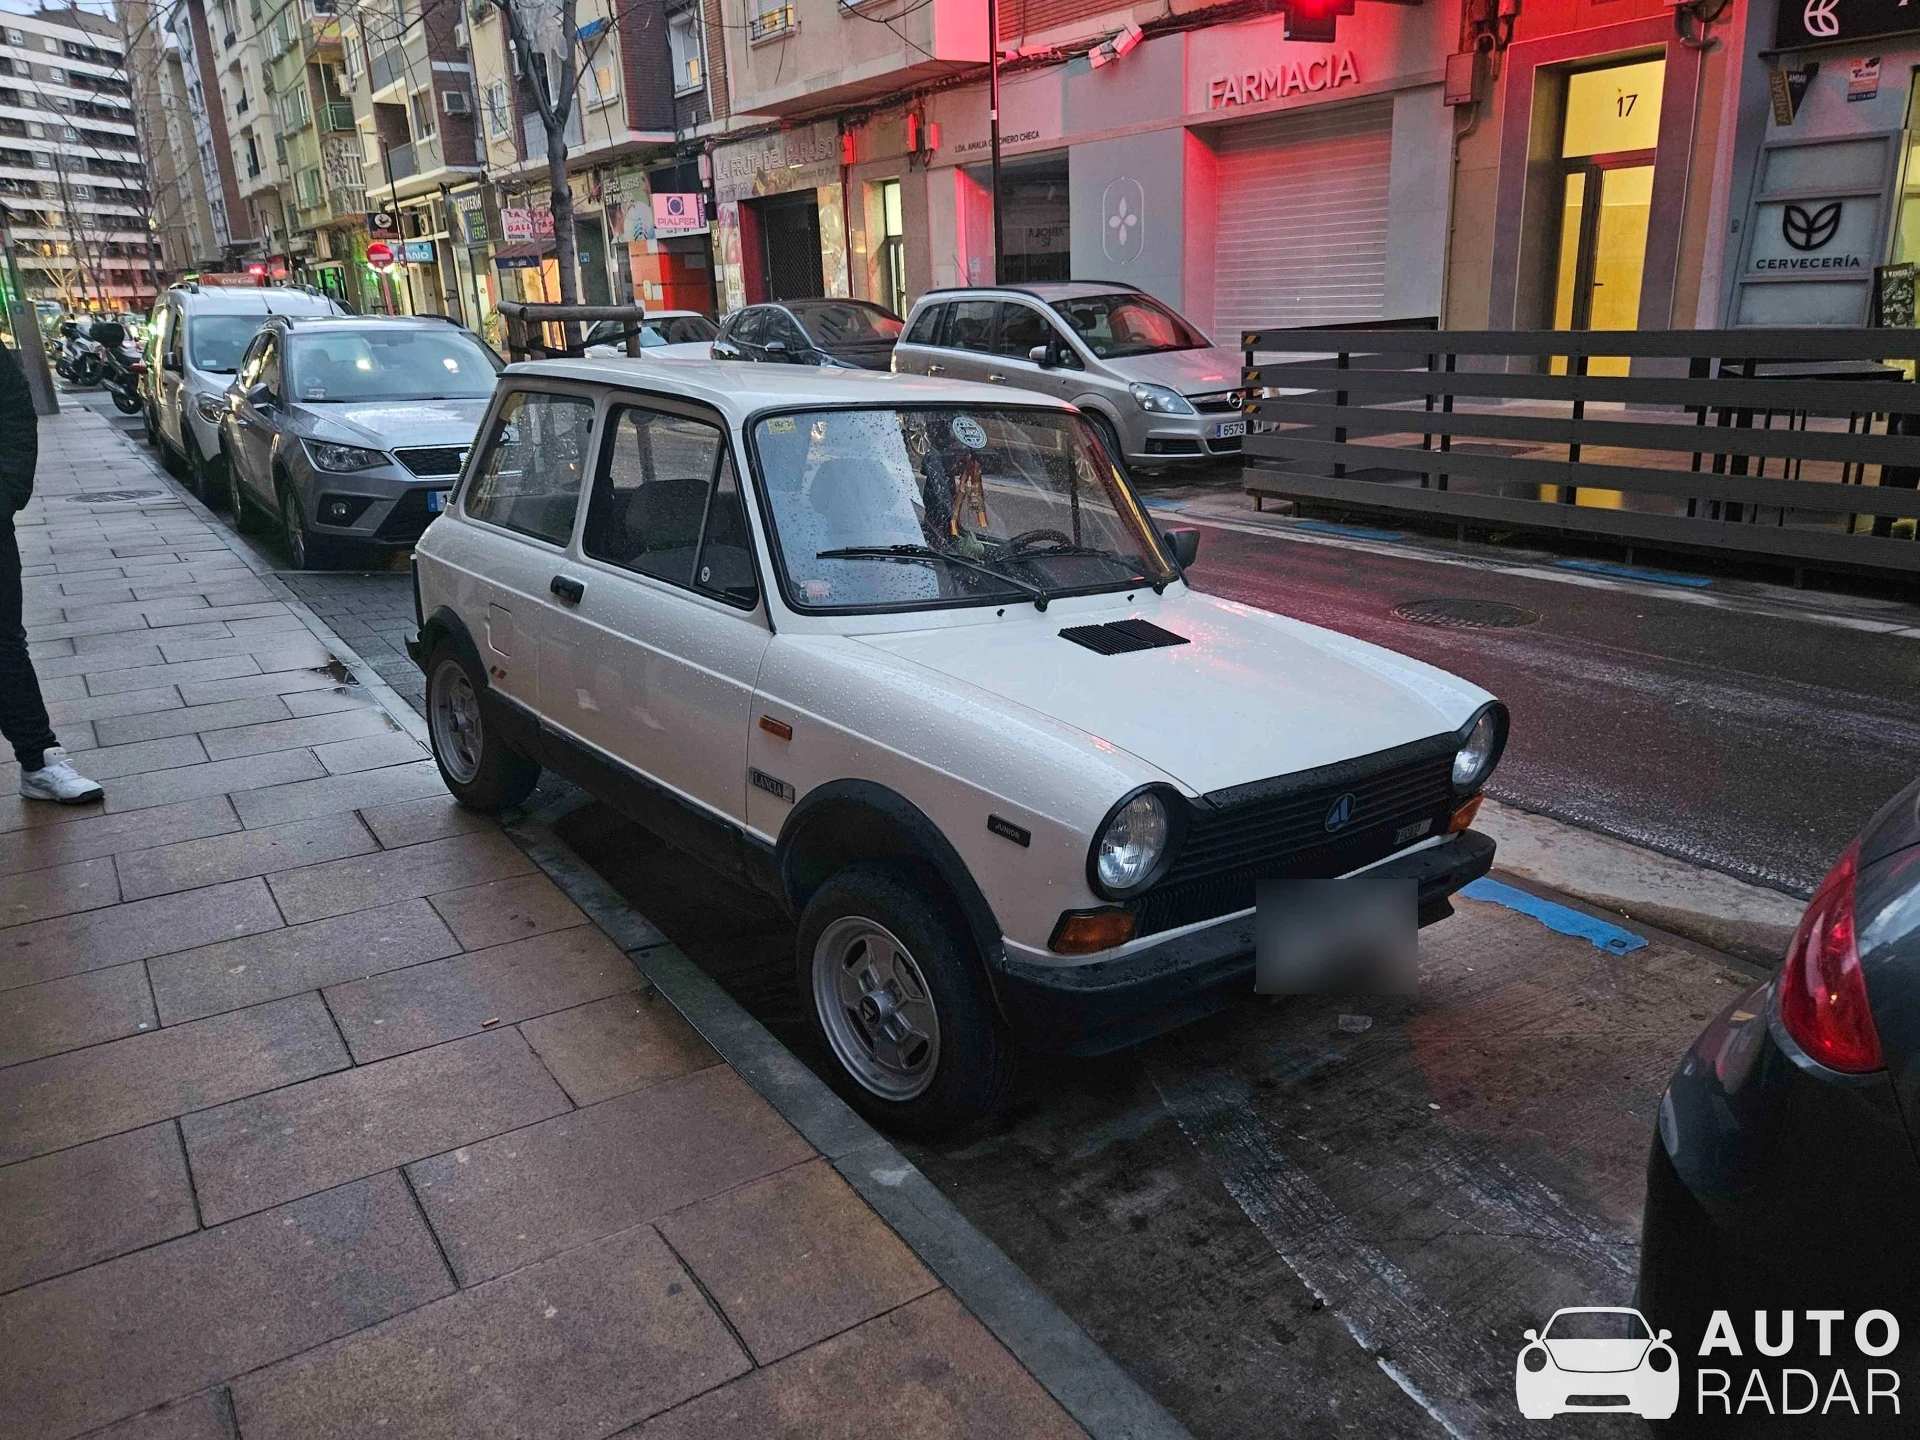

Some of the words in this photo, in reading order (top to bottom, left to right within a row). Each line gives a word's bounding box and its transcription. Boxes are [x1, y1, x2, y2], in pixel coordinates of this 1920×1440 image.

[1207, 51, 1360, 110] FARMACIA
[1617, 94, 1638, 117] 17
[967, 140, 987, 151] AMALIA
[989, 134, 1019, 146] COMERO
[1020, 131, 1040, 141] CHECA
[715, 160, 731, 180] LA
[731, 152, 763, 177] FRUTA
[763, 148, 785, 172] DEL
[697, 194, 706, 226] PINTURAS
[658, 217, 696, 226] PIALFER
[1756, 255, 1860, 269] CERVECERÍA
[1224, 424, 1244, 435] 6579
[754, 772, 782, 796] LANCIA
[996, 823, 1020, 839] JUNIOR
